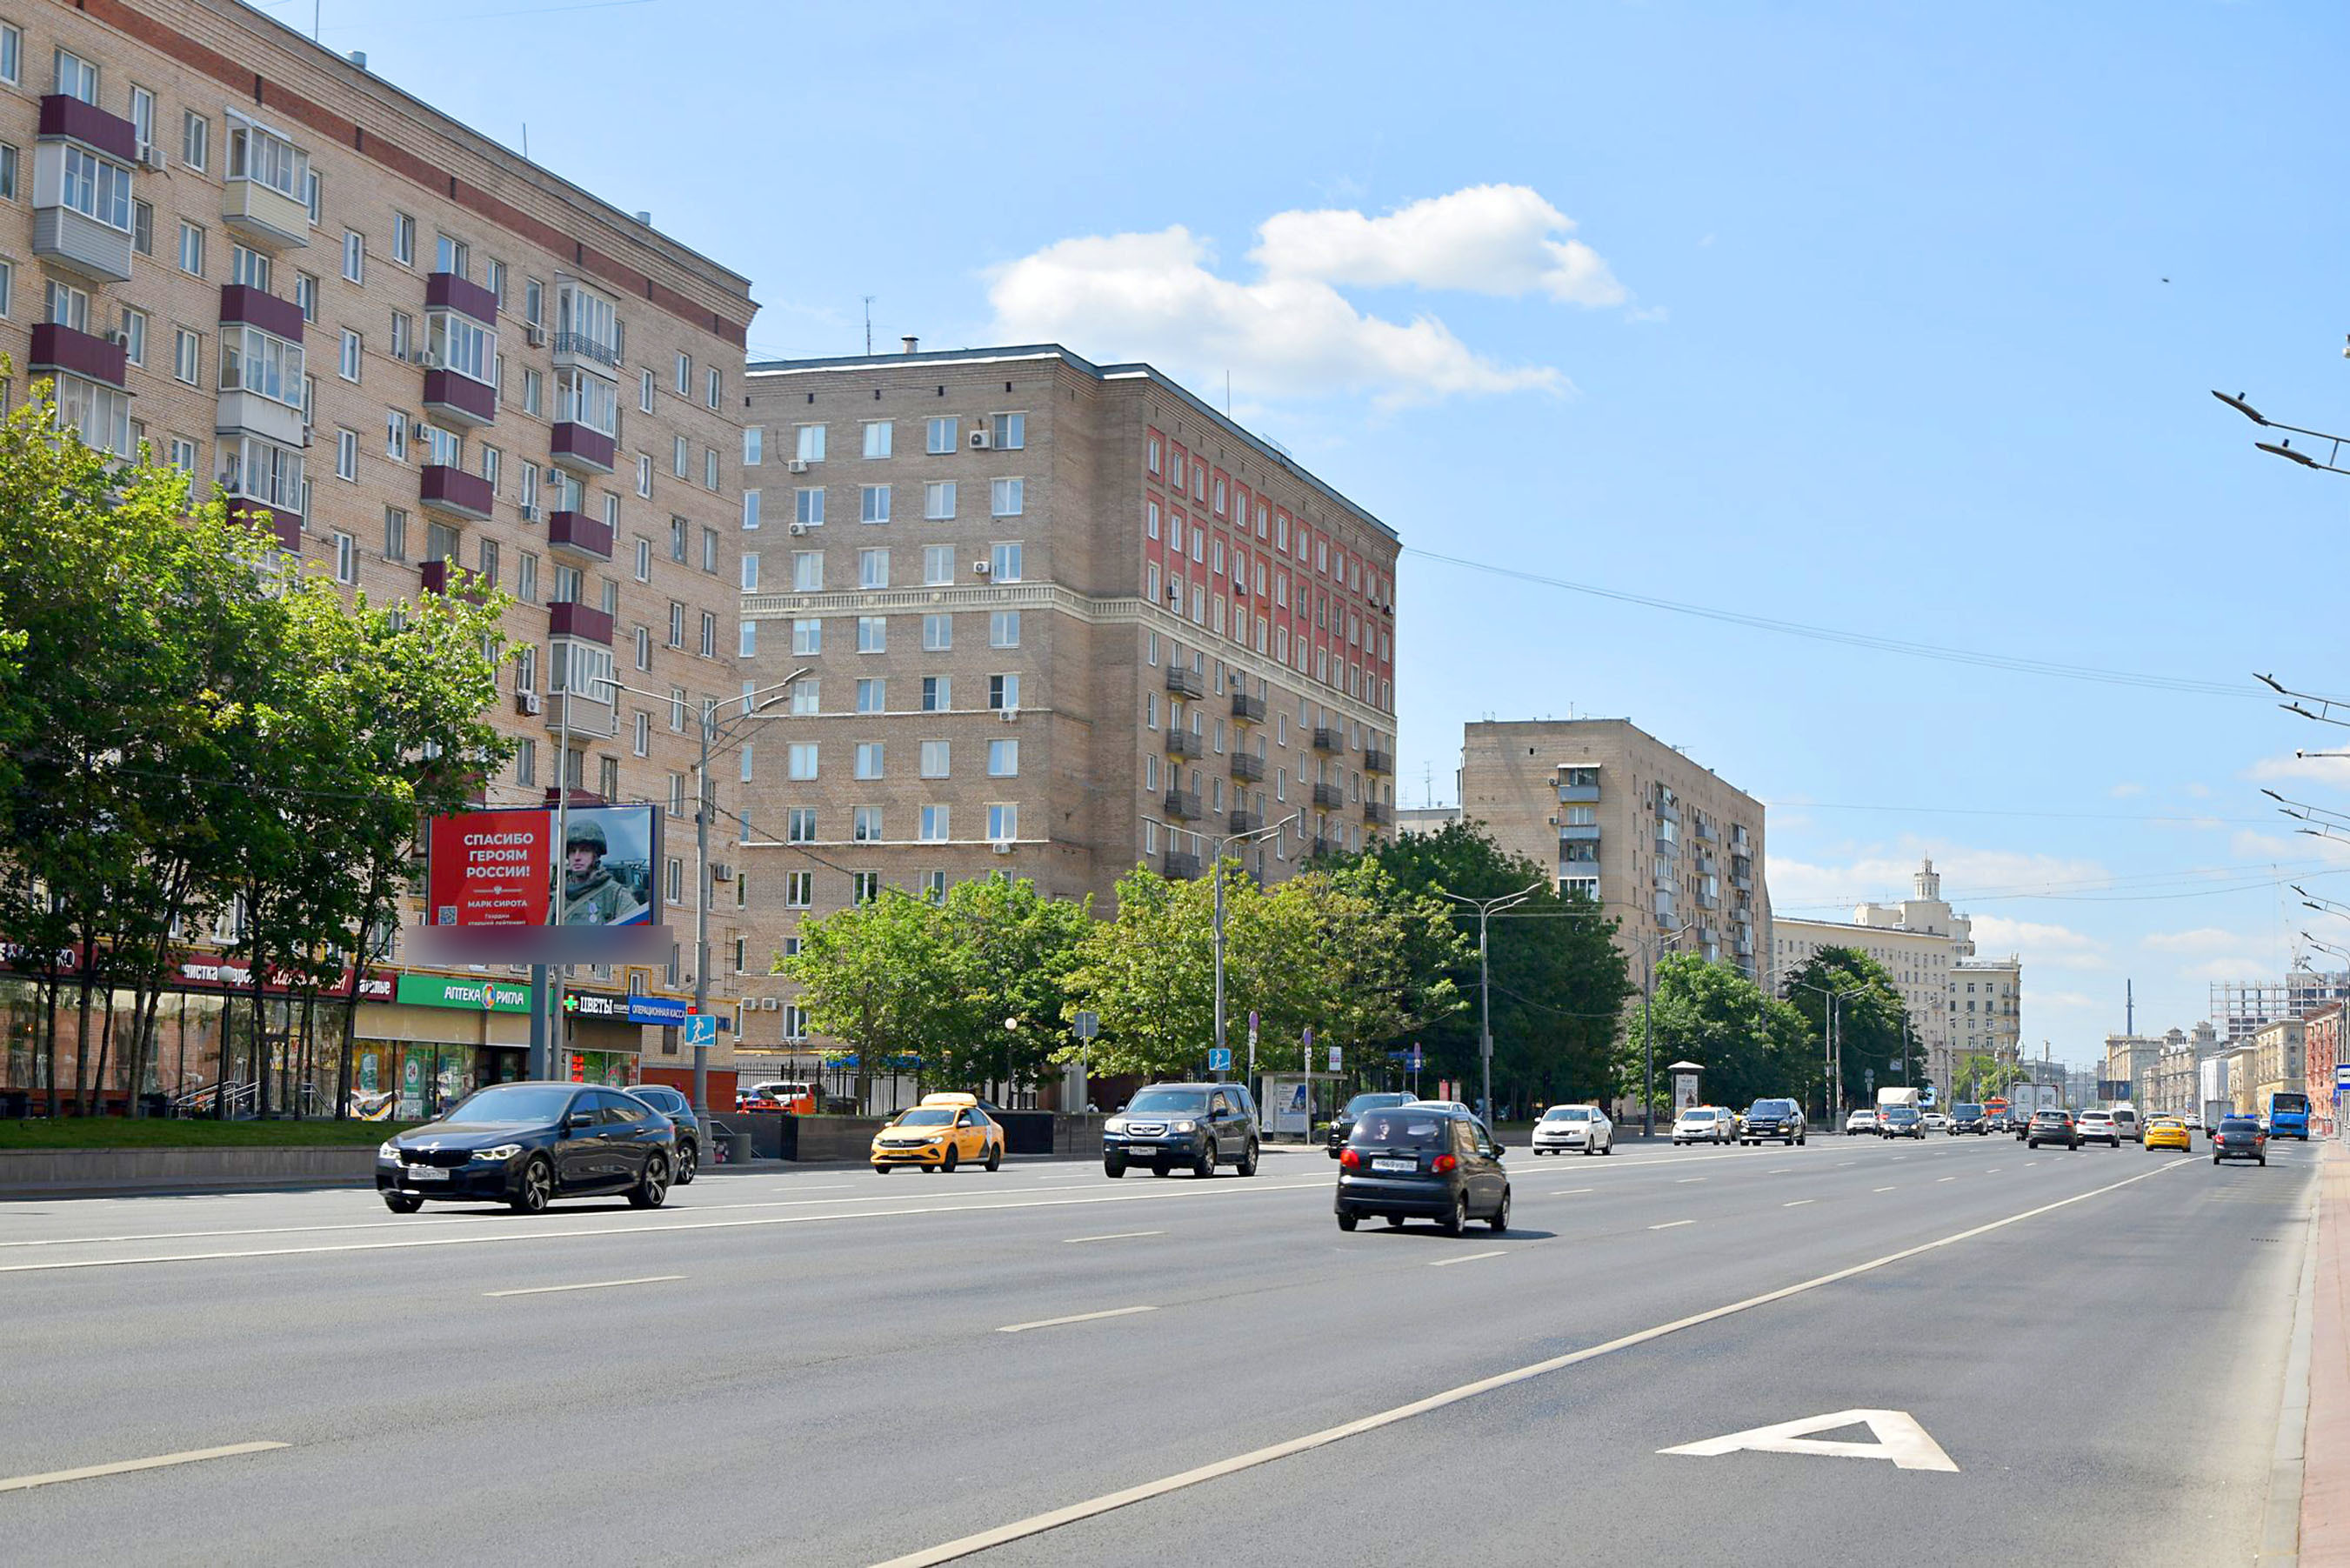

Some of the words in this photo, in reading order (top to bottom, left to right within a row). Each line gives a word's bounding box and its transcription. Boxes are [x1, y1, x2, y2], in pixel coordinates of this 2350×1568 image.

[464, 832, 534, 845] СПАСИБО
[469, 849, 528, 862] ГЕРОЯМ
[466, 865, 531, 878] РОССИИ!
[467, 899, 492, 908] МАРК
[444, 985, 481, 1002] АПТЕКА
[496, 991, 524, 1005] РИГЛА
[579, 996, 613, 1015] ЦВЕТЫ
[631, 1004, 670, 1018] ОПЕРАЦИОННАЯ
[1655, 1409, 1959, 1471] А
